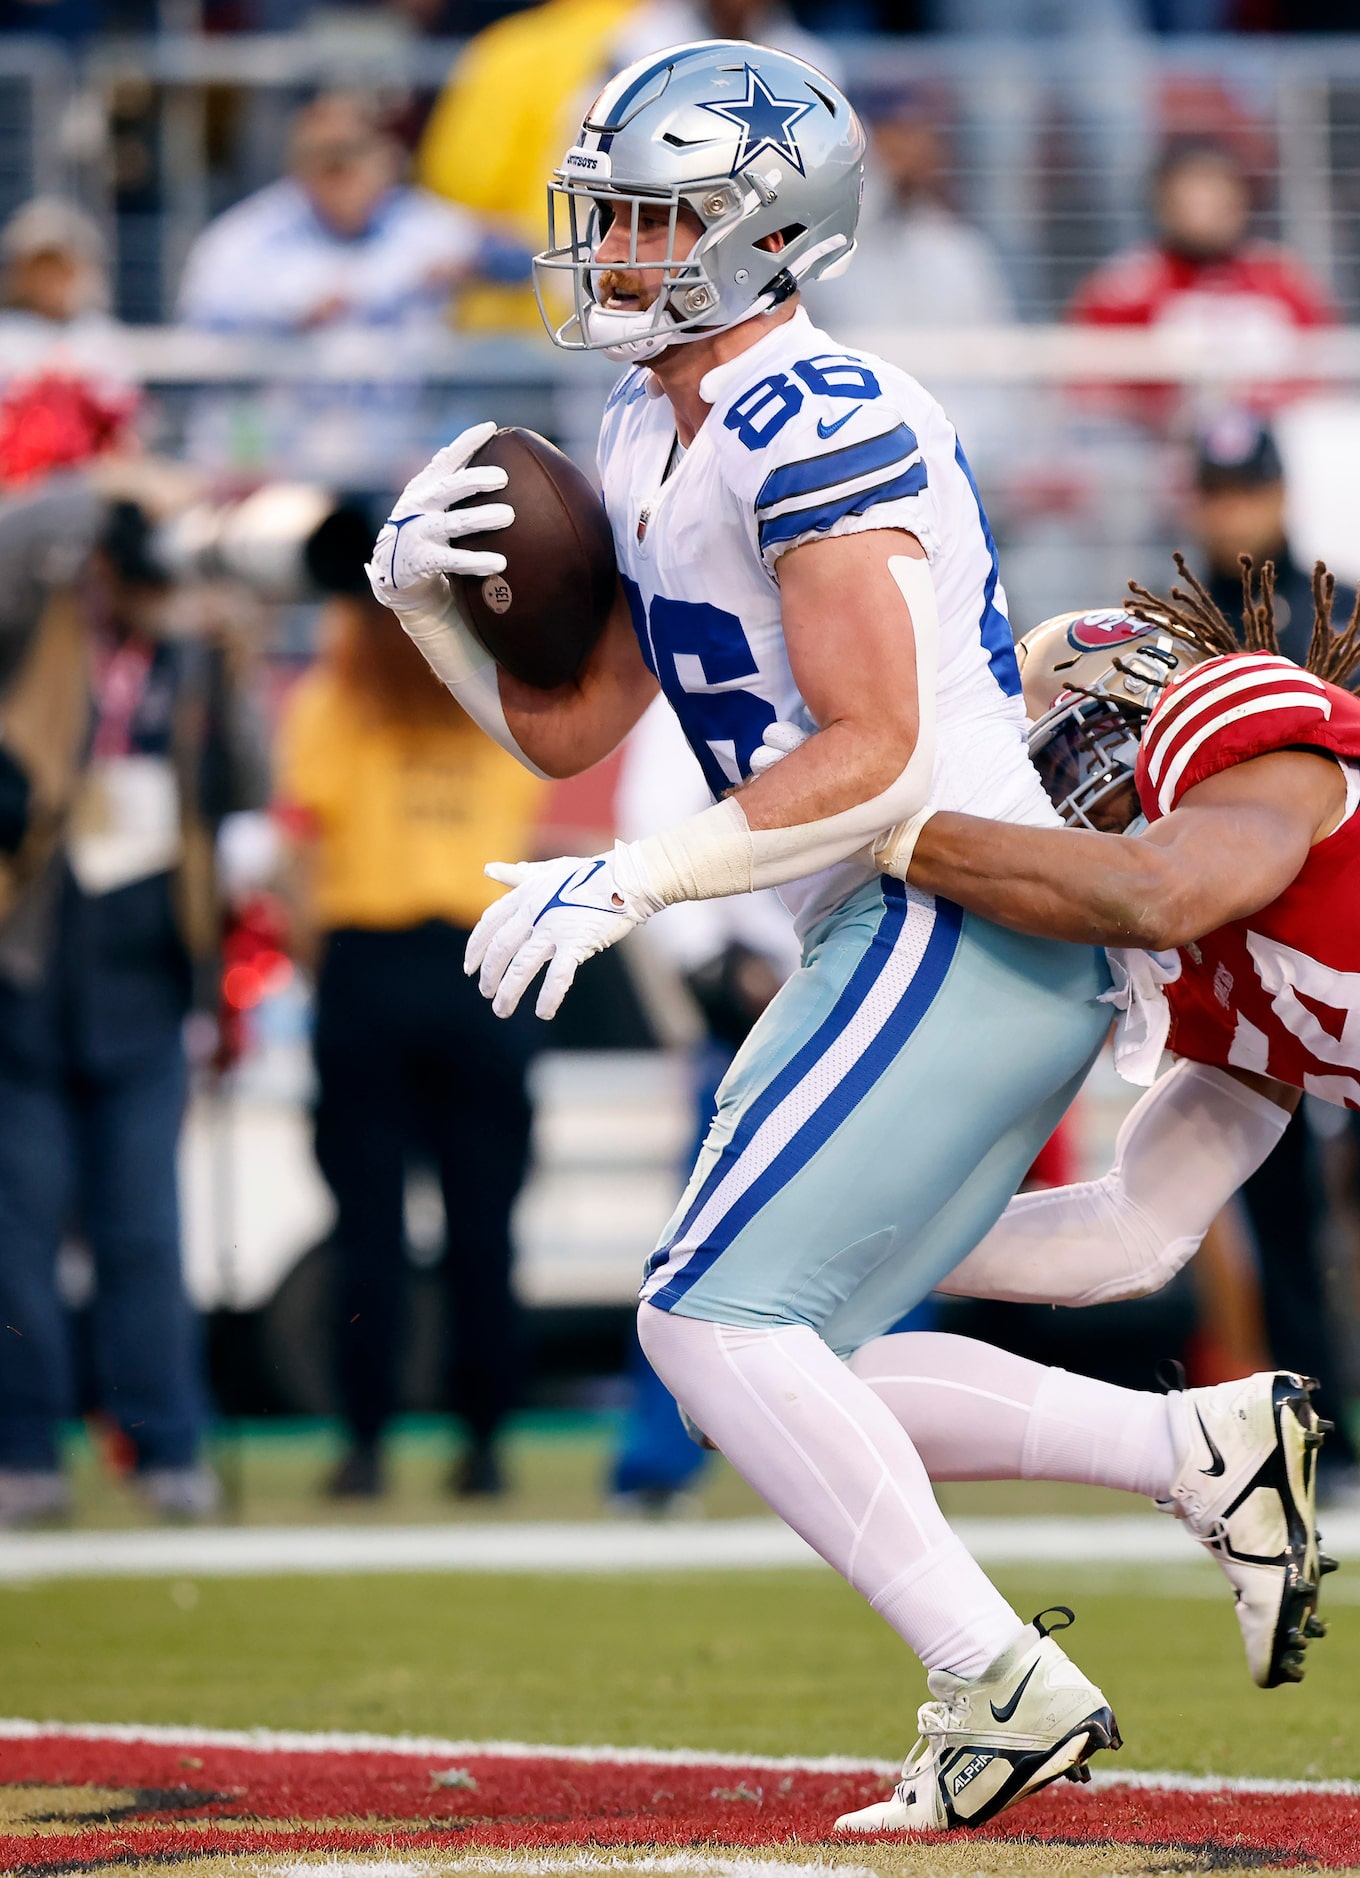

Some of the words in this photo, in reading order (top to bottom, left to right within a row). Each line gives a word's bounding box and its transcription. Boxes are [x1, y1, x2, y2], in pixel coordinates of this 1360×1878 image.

[723, 354, 882, 451] 86
[495, 586, 510, 603] 135
[955, 1754, 994, 1794] ALPHA
